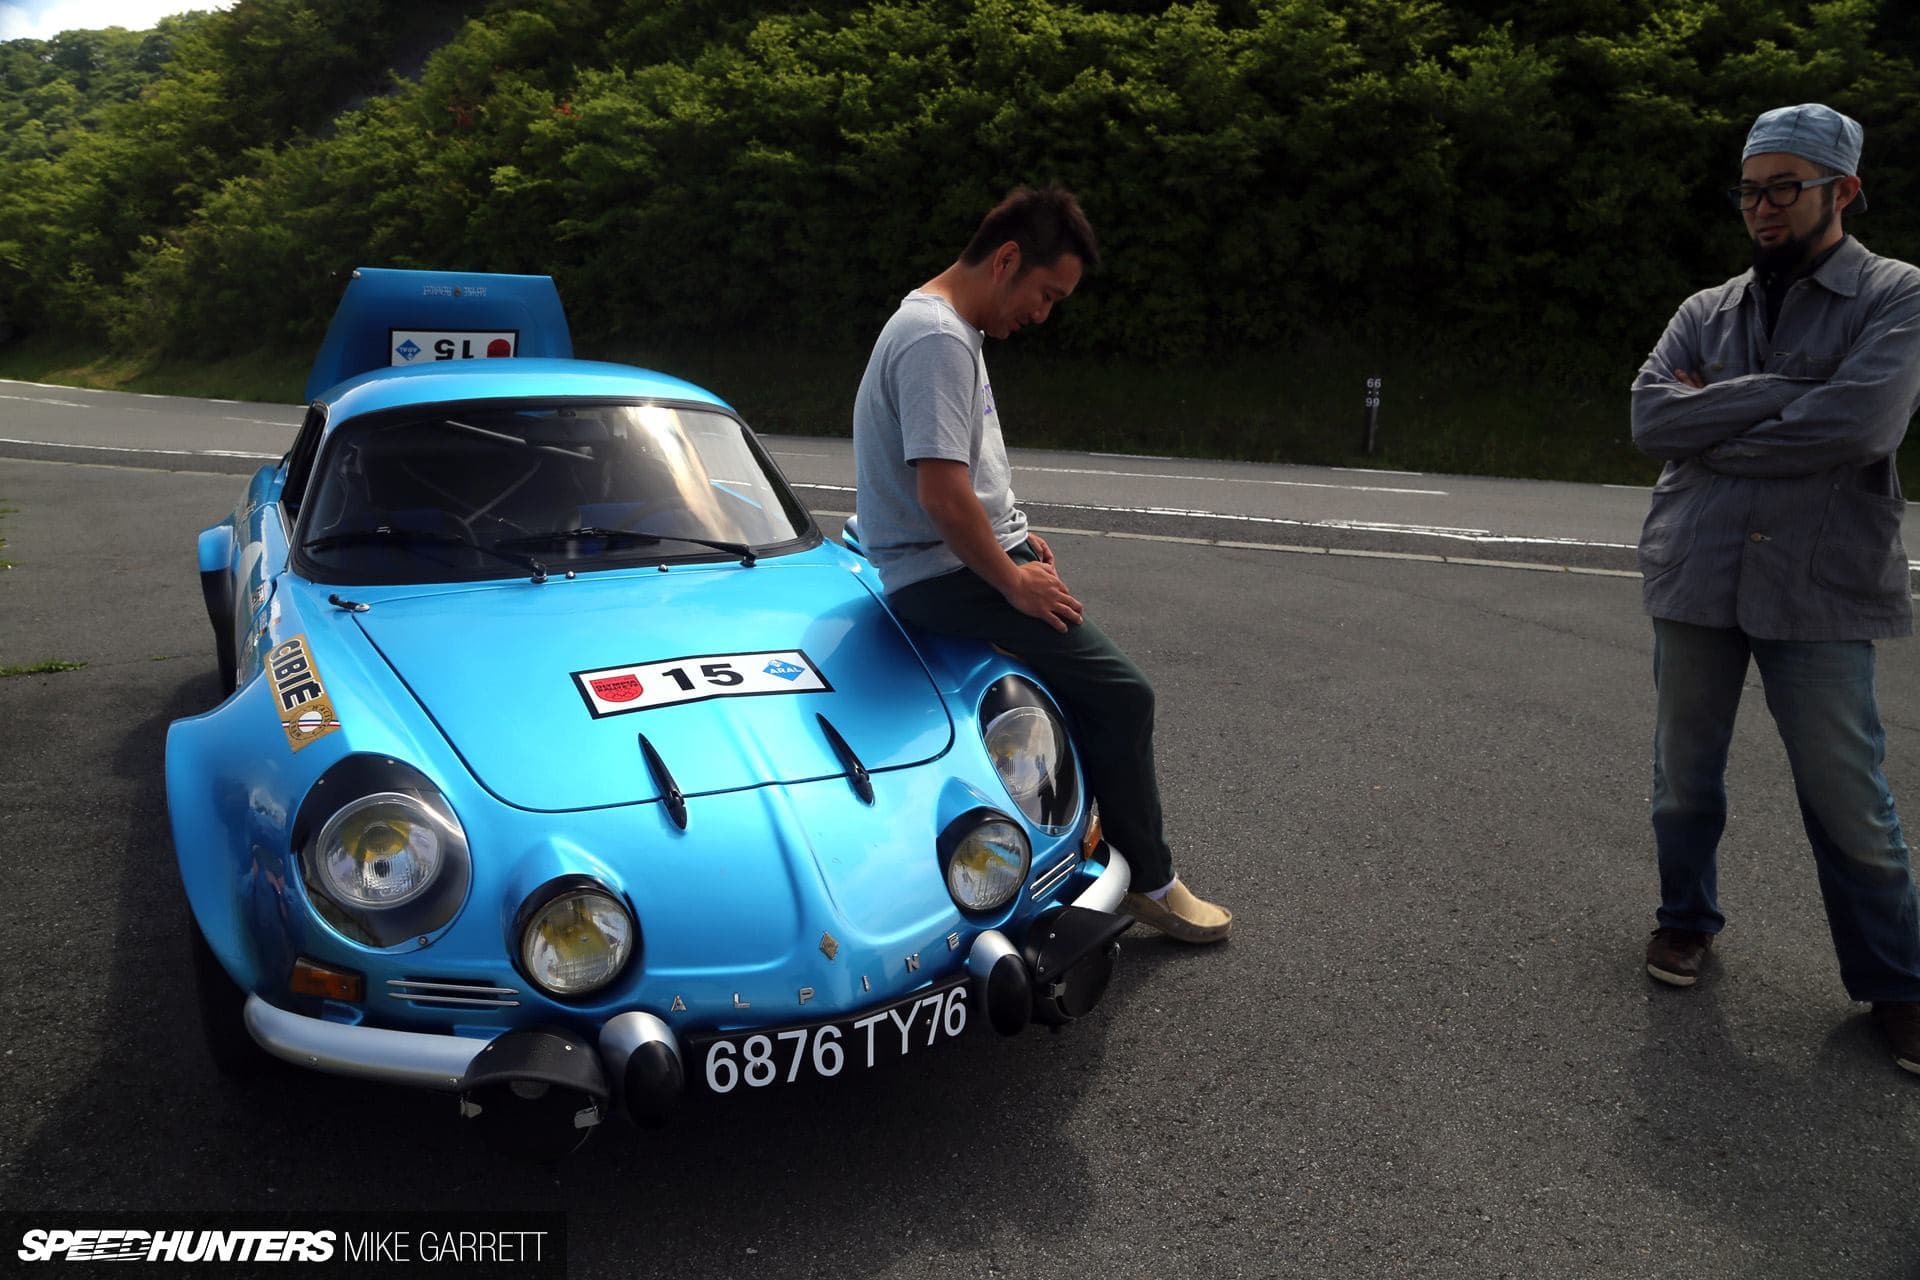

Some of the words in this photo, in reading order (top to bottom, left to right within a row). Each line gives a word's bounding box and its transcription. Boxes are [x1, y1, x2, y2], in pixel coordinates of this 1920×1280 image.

[434, 339, 474, 361] 15
[1367, 378, 1381, 388] 66
[661, 663, 744, 691] 15
[769, 665, 802, 674] ARAL
[671, 932, 960, 1012] ALPINE
[705, 1025, 844, 1094] 6876
